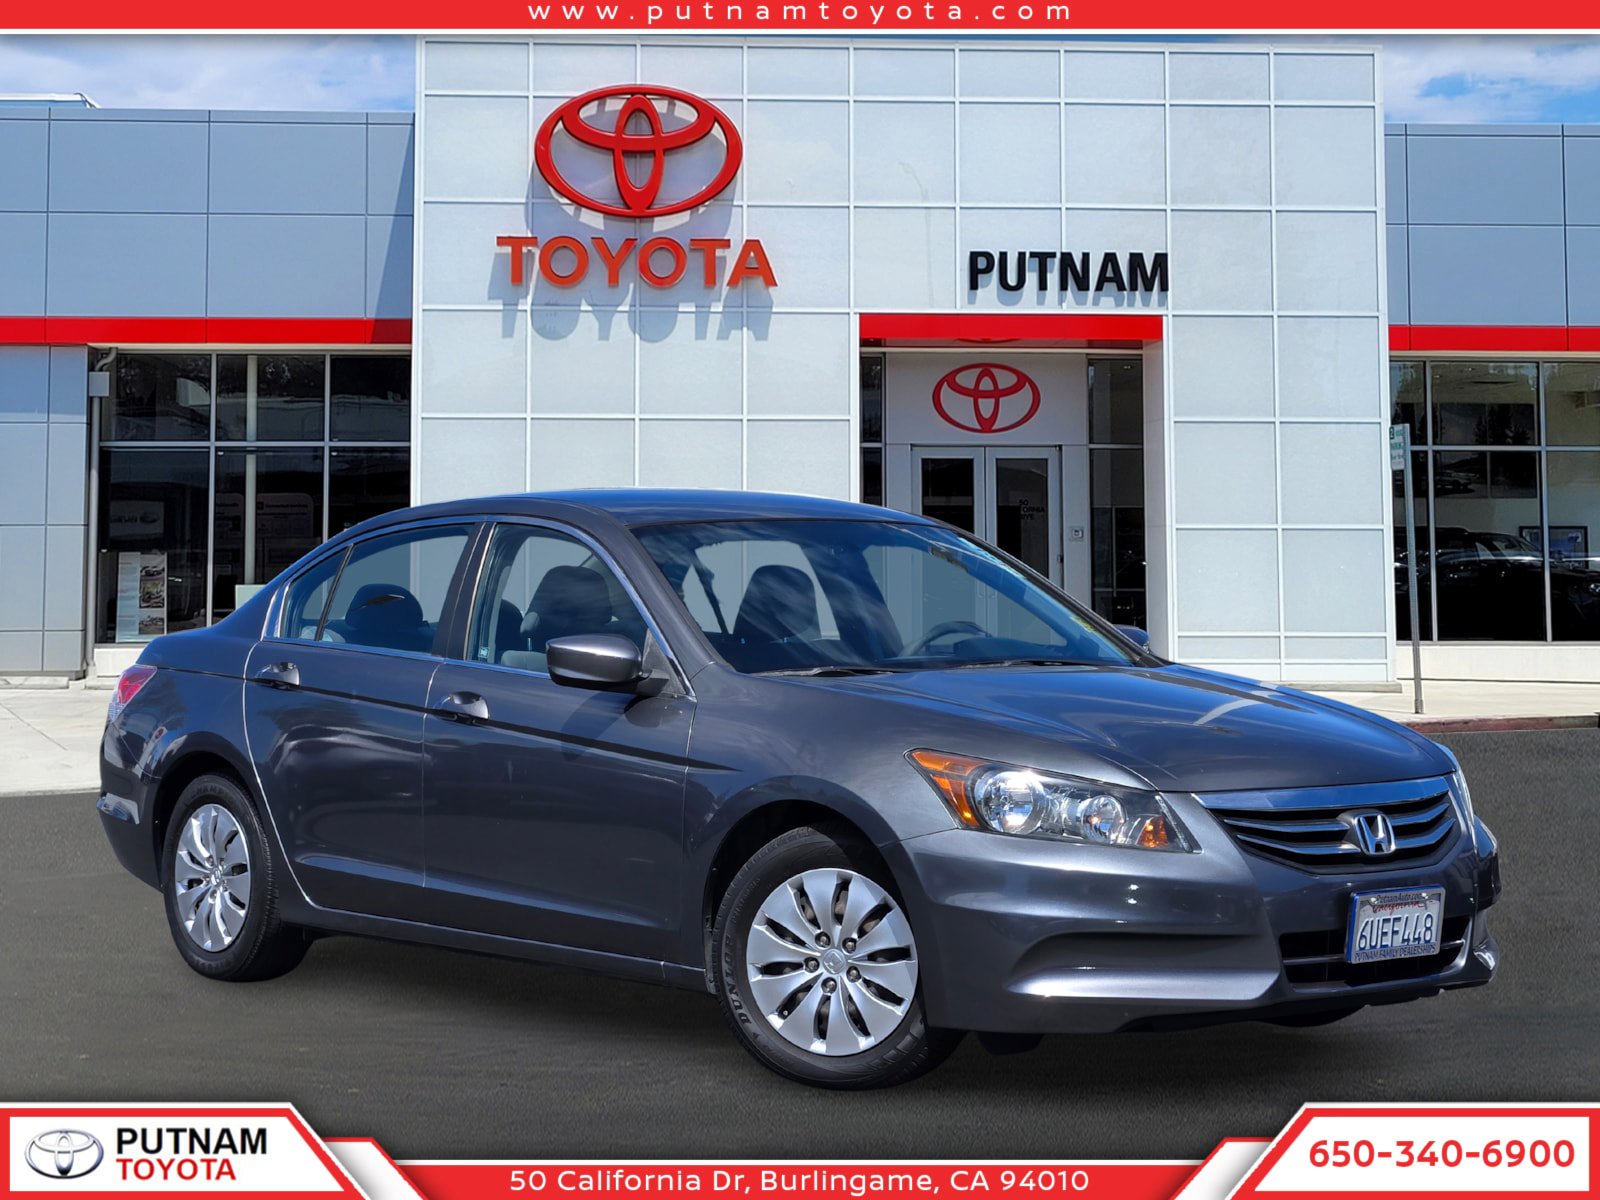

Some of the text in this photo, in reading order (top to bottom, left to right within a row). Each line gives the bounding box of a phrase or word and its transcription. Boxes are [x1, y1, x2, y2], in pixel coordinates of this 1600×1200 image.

[497, 236, 778, 288] TOYOTA
[969, 251, 1169, 292] PUTNAM
[1358, 913, 1434, 951] 6UEF448
[724, 934, 752, 1026] DUNLOP
